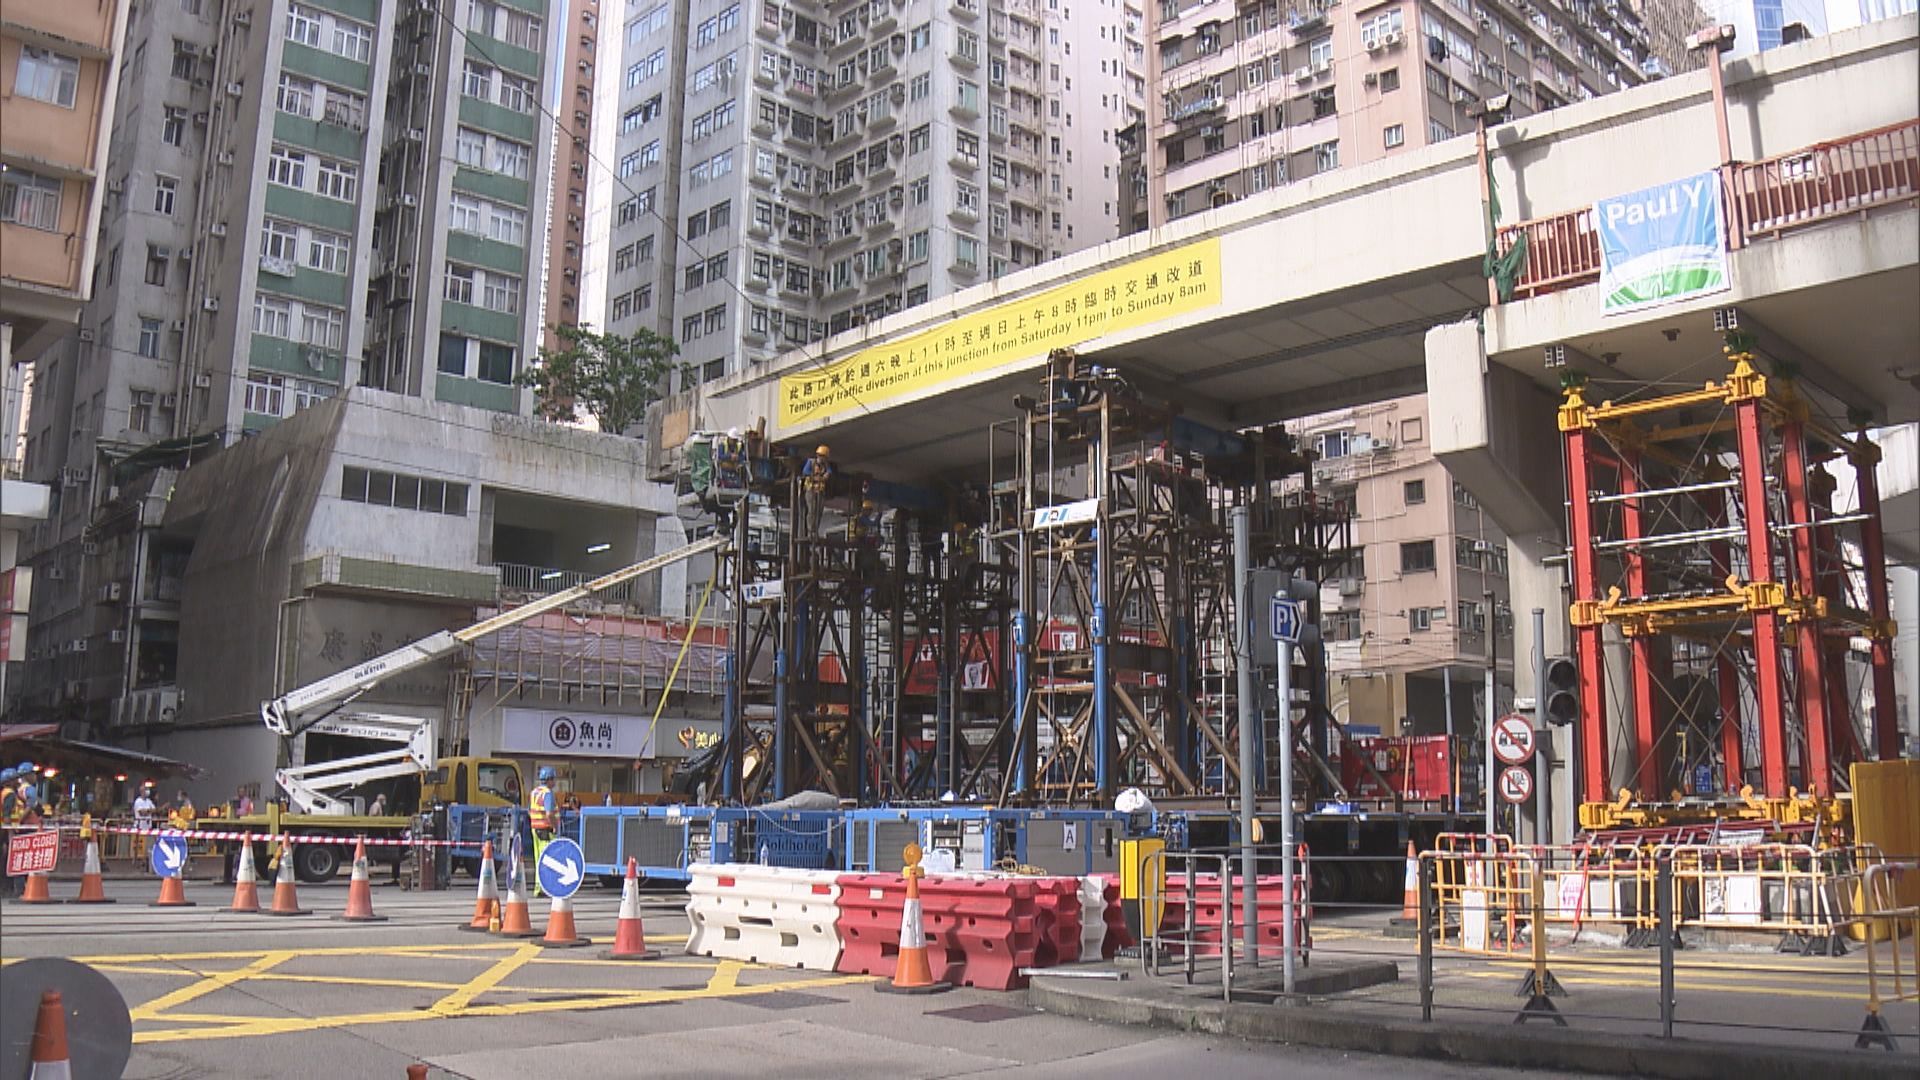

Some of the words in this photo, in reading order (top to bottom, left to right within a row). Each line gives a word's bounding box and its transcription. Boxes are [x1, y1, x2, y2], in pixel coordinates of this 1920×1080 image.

[1606, 189, 1678, 229] Paul
[1681, 179, 1704, 209] Y
[788, 394, 834, 415] Temporary
[836, 384, 864, 401] traffic
[865, 372, 910, 392] diversion
[911, 366, 923, 378] at
[924, 360, 943, 375] this
[944, 346, 990, 371] junction
[991, 336, 1018, 352] from
[1020, 321, 1073, 346] Saturday
[1076, 312, 1107, 330] 11pm
[1111, 305, 1124, 318] to
[1127, 290, 1175, 313] Sunday
[1179, 282, 1207, 299] 8am
[1276, 605, 1289, 634] P
[578, 720, 613, 741] 魚尚
[12, 839, 31, 850] ROAD
[32, 834, 57, 848] CLOSED
[759, 836, 819, 852] Goldhofer
[1065, 828, 1075, 844] A
